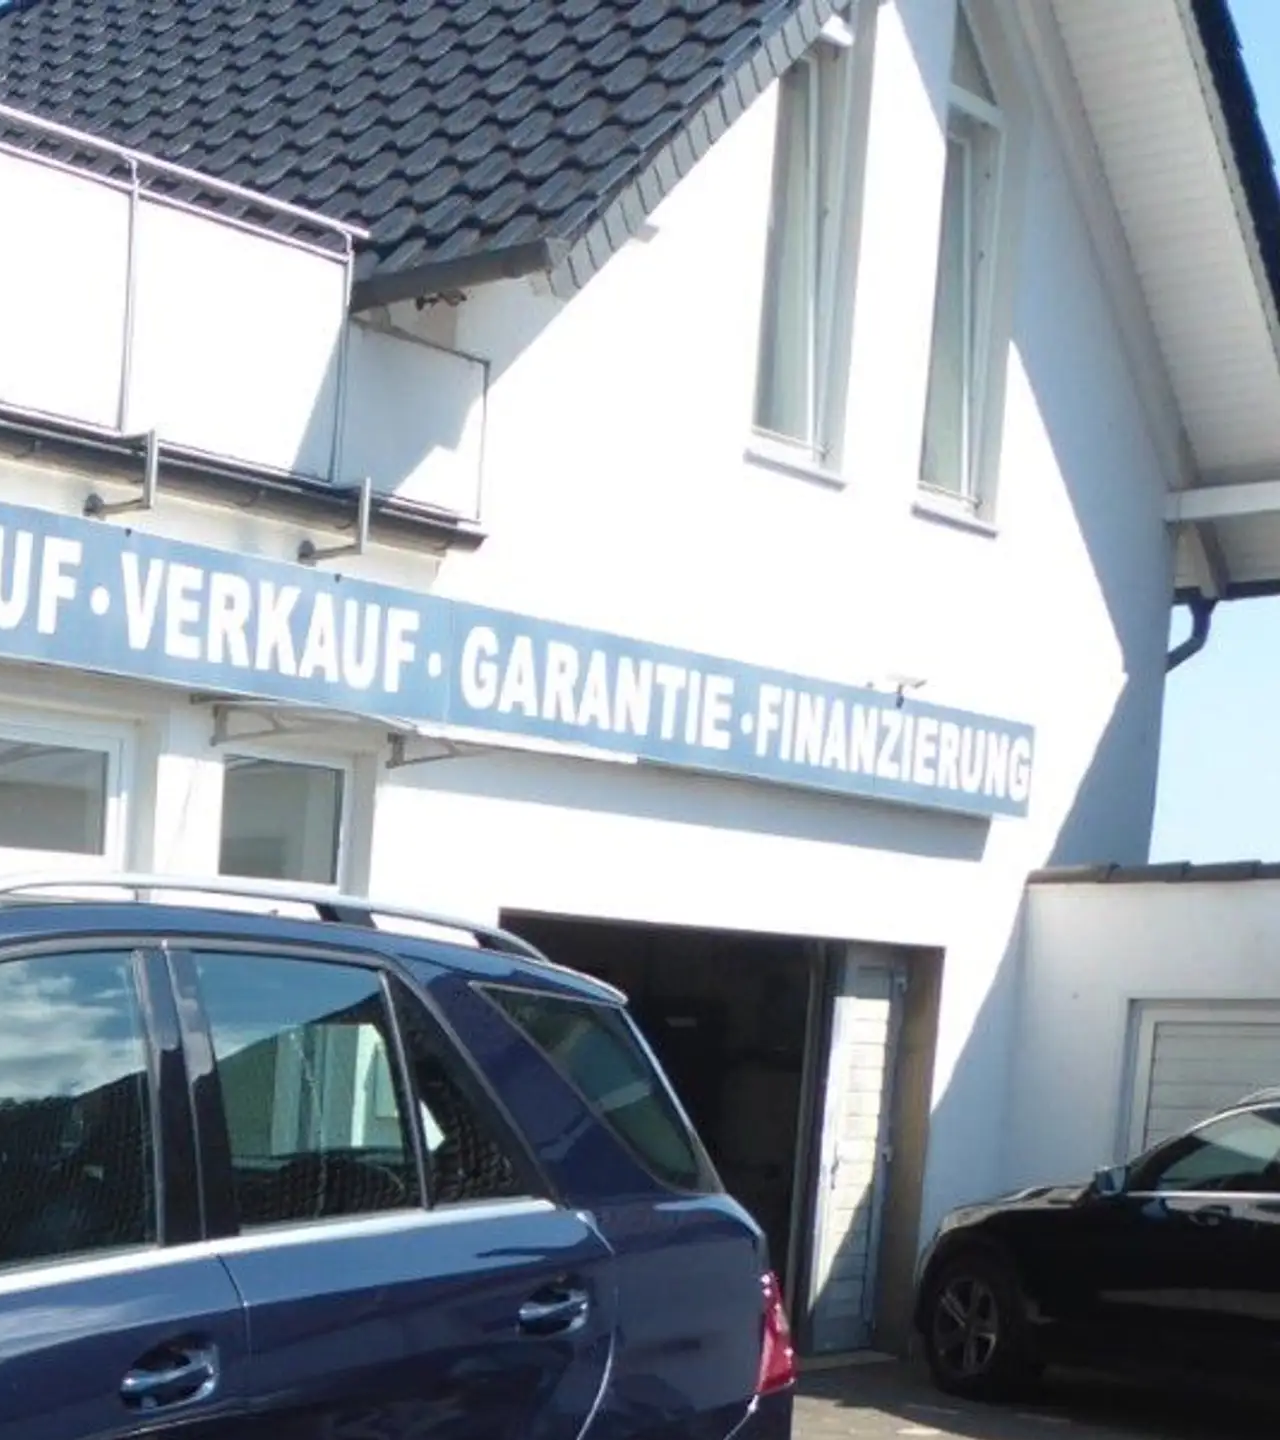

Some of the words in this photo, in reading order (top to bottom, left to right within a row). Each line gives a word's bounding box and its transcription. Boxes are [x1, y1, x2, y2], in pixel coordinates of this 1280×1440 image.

[120, 552, 420, 692] VERKAUF
[460, 626, 734, 751] GARANTIE
[755, 687, 1032, 802] FINANZIERUNG
